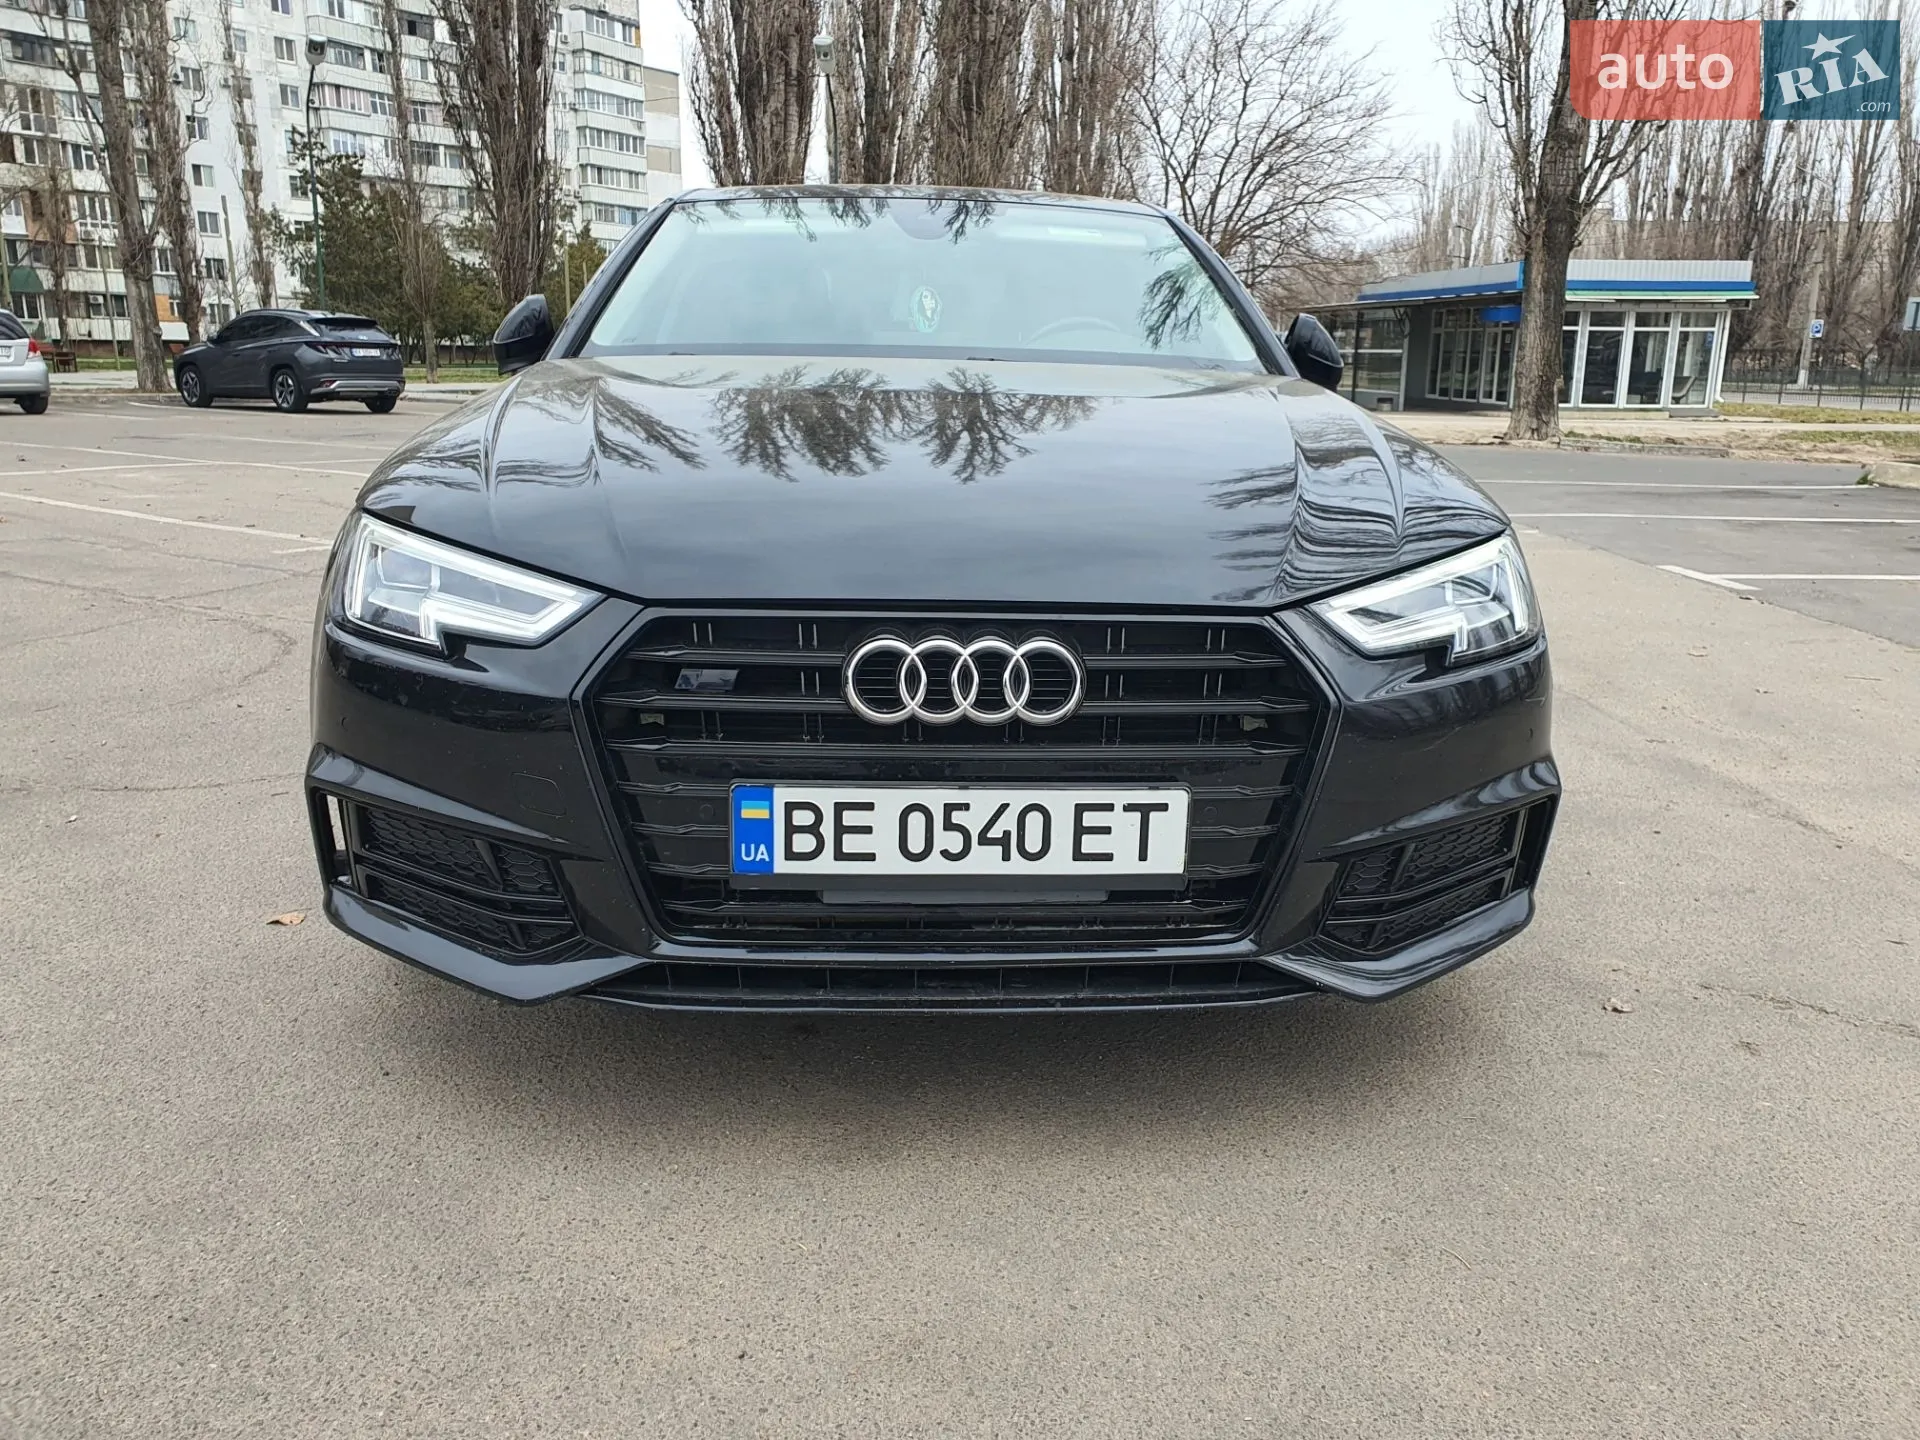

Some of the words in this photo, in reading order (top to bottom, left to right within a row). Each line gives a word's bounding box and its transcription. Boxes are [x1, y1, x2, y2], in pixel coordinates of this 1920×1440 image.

[784, 801, 877, 862] BE
[899, 802, 1051, 862] 0540
[1072, 802, 1169, 862] ET
[741, 844, 769, 862] UA
